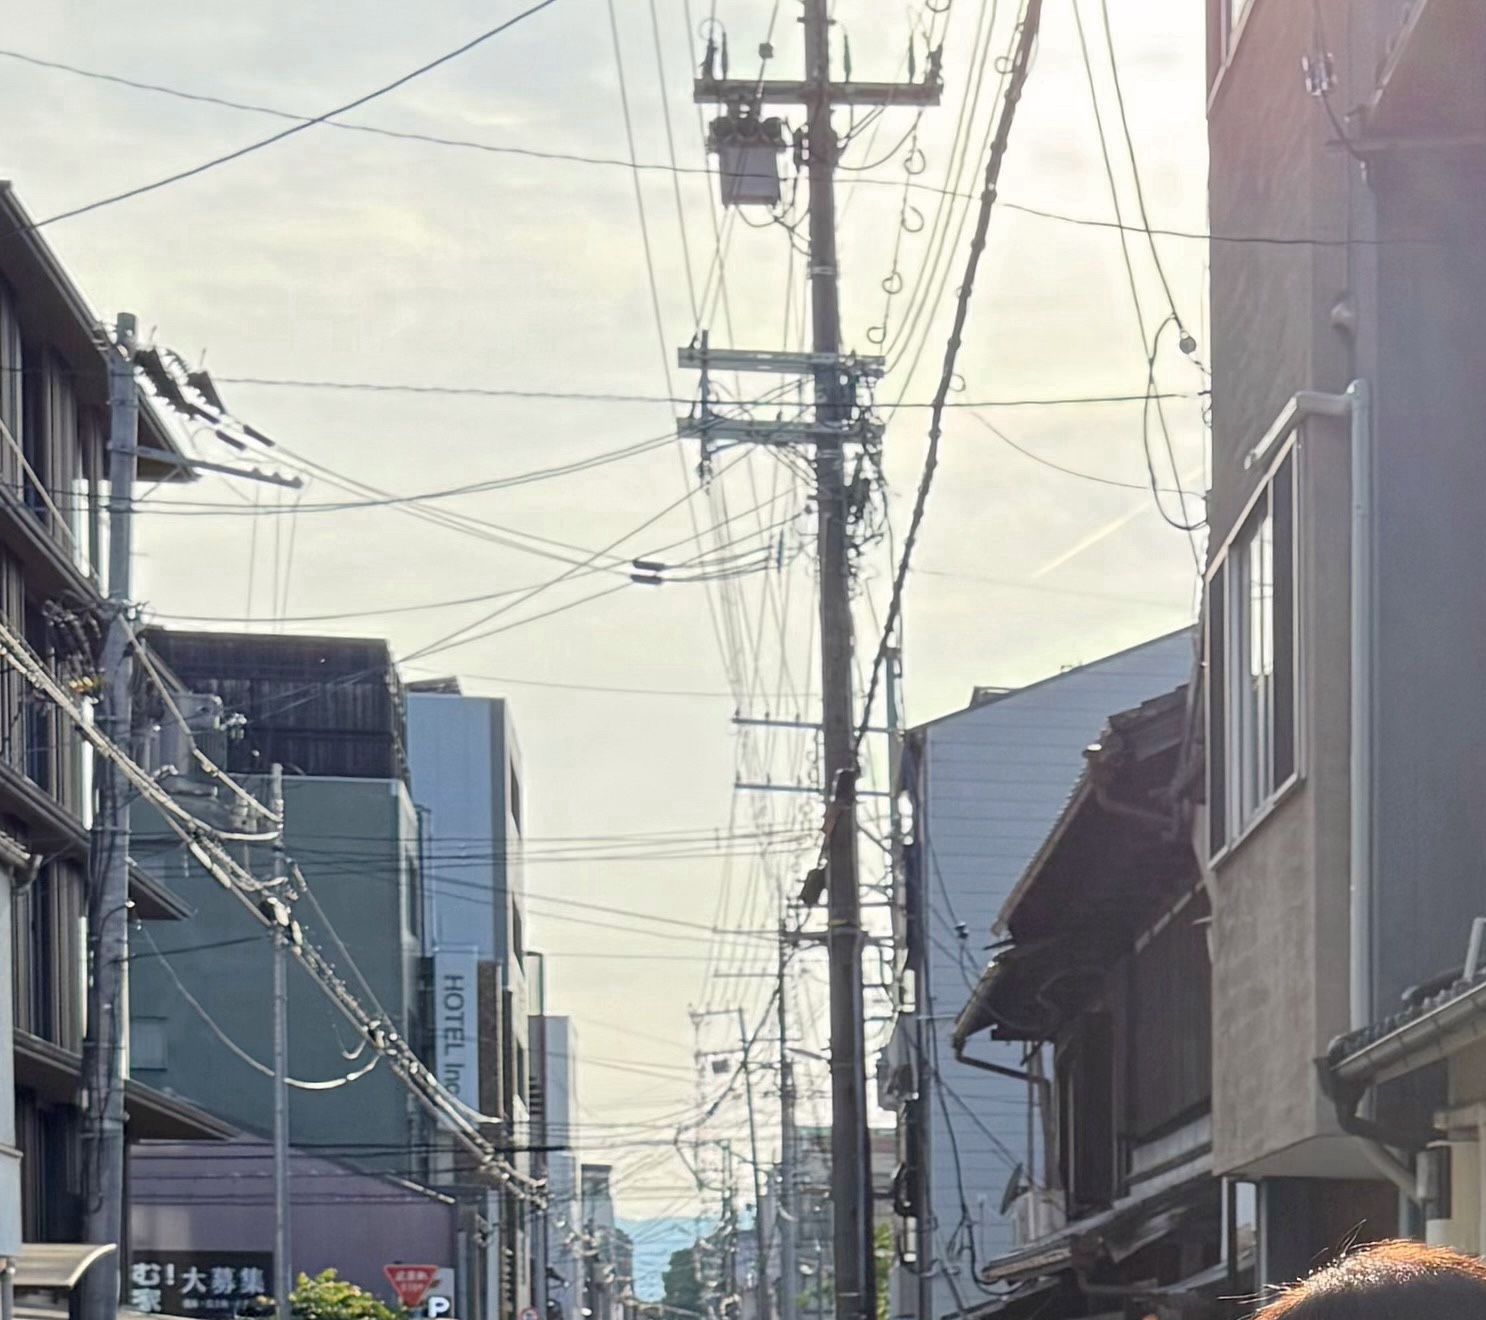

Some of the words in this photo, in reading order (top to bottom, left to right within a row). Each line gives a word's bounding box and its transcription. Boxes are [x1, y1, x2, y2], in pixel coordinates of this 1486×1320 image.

[444, 975, 465, 1056] HOTEL
[181, 1266, 265, 1295] 大募集
[428, 1296, 450, 1318] P
